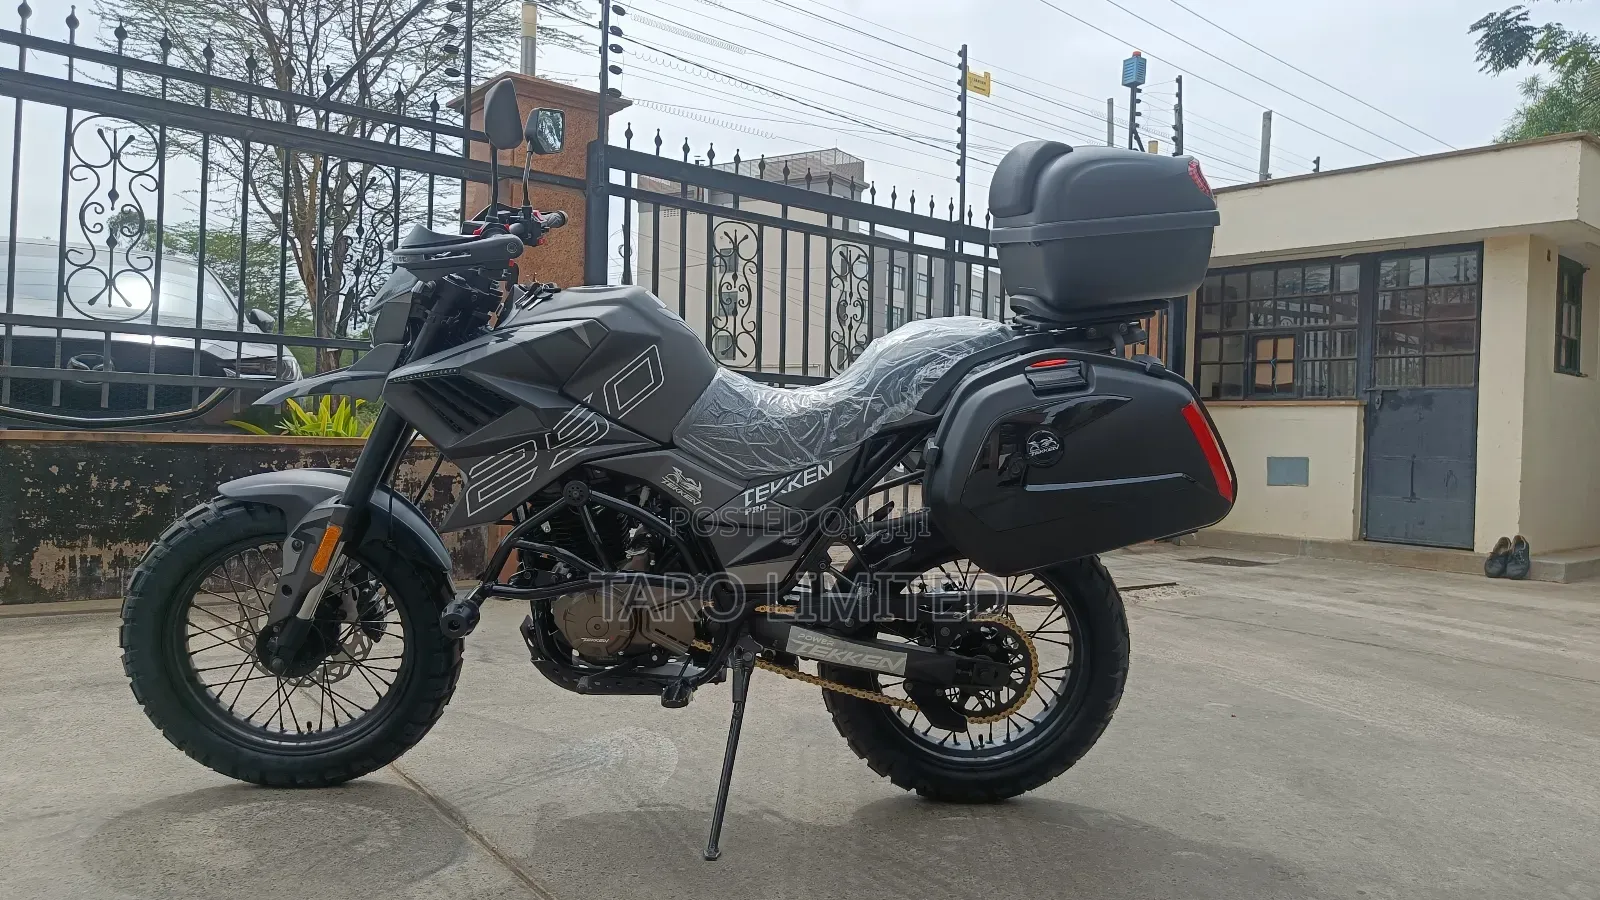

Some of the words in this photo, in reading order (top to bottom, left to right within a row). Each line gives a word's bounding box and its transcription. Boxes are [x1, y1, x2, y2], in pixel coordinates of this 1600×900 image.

[661, 476, 702, 505] TEKKEN
[739, 460, 832, 507] TEKKEN
[745, 504, 767, 515] PRO
[798, 633, 834, 646] POWER
[792, 639, 906, 672] TEKKEN
